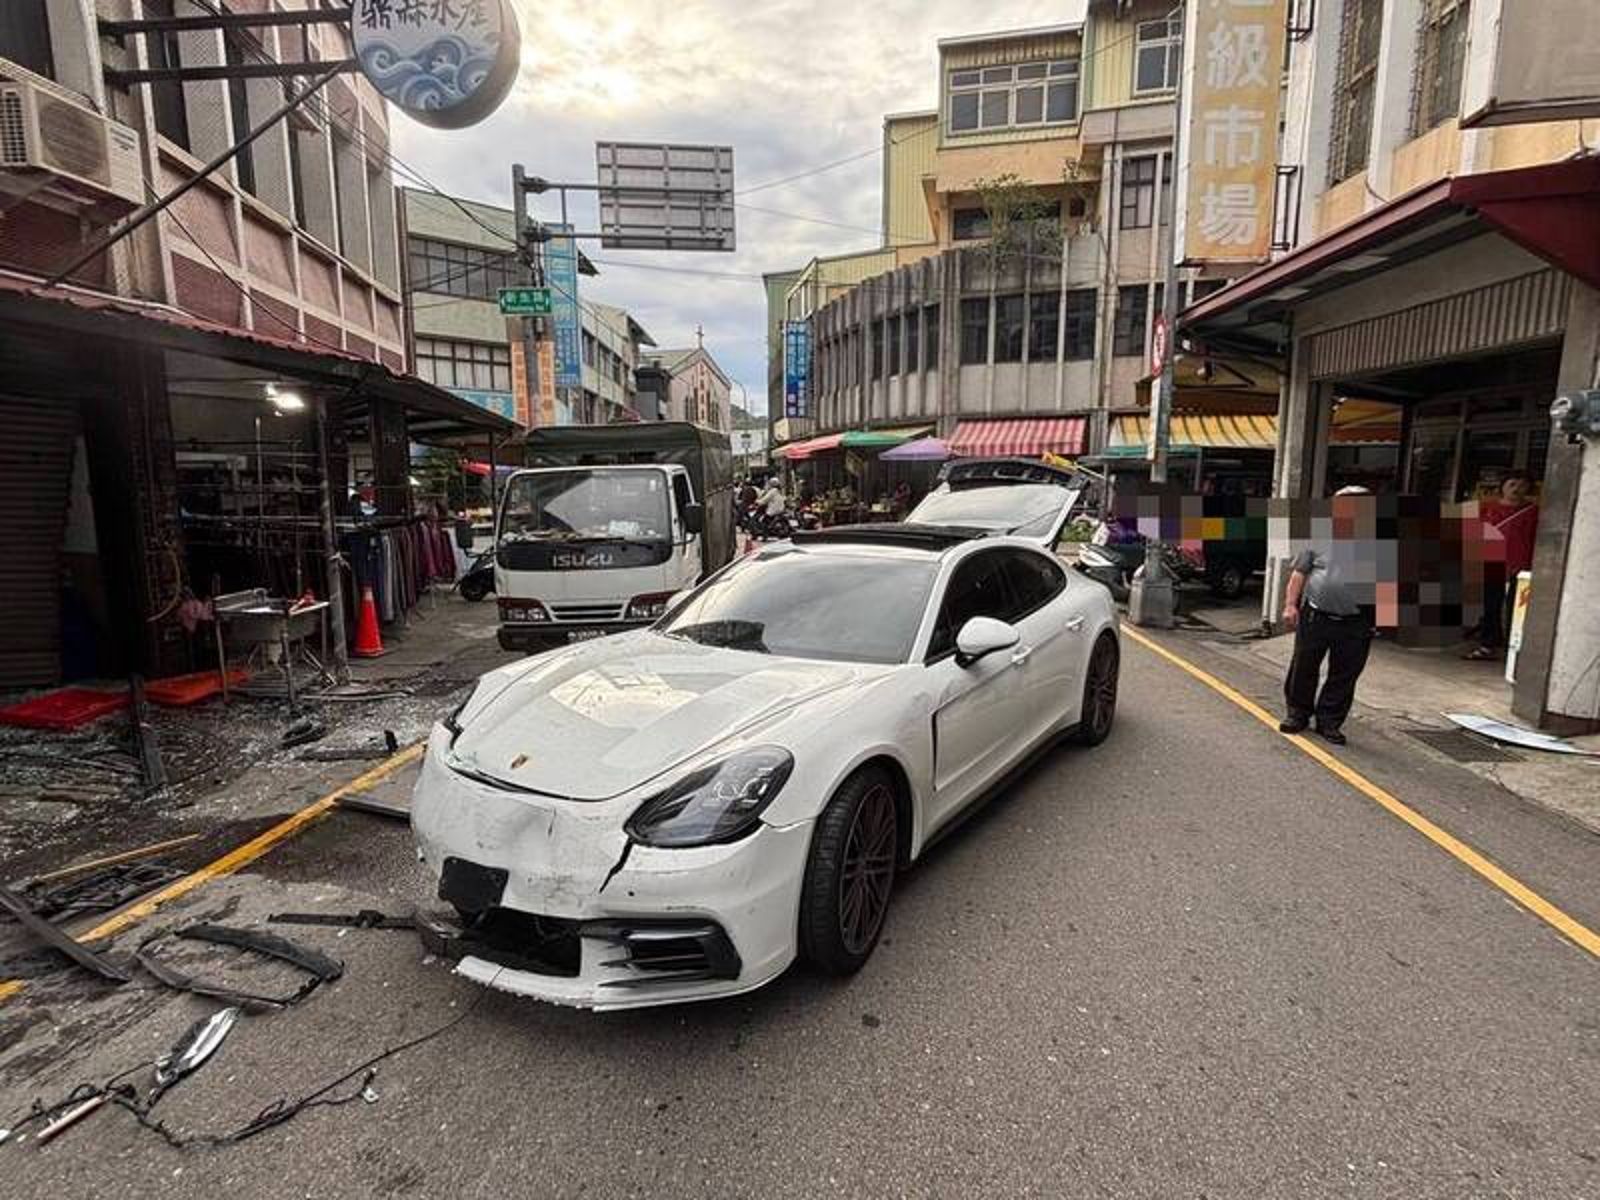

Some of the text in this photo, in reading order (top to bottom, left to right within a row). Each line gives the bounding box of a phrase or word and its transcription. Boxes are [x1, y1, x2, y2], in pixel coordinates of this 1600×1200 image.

[1199, 0, 1274, 245] 級市場
[552, 552, 614, 567] ISUZU
